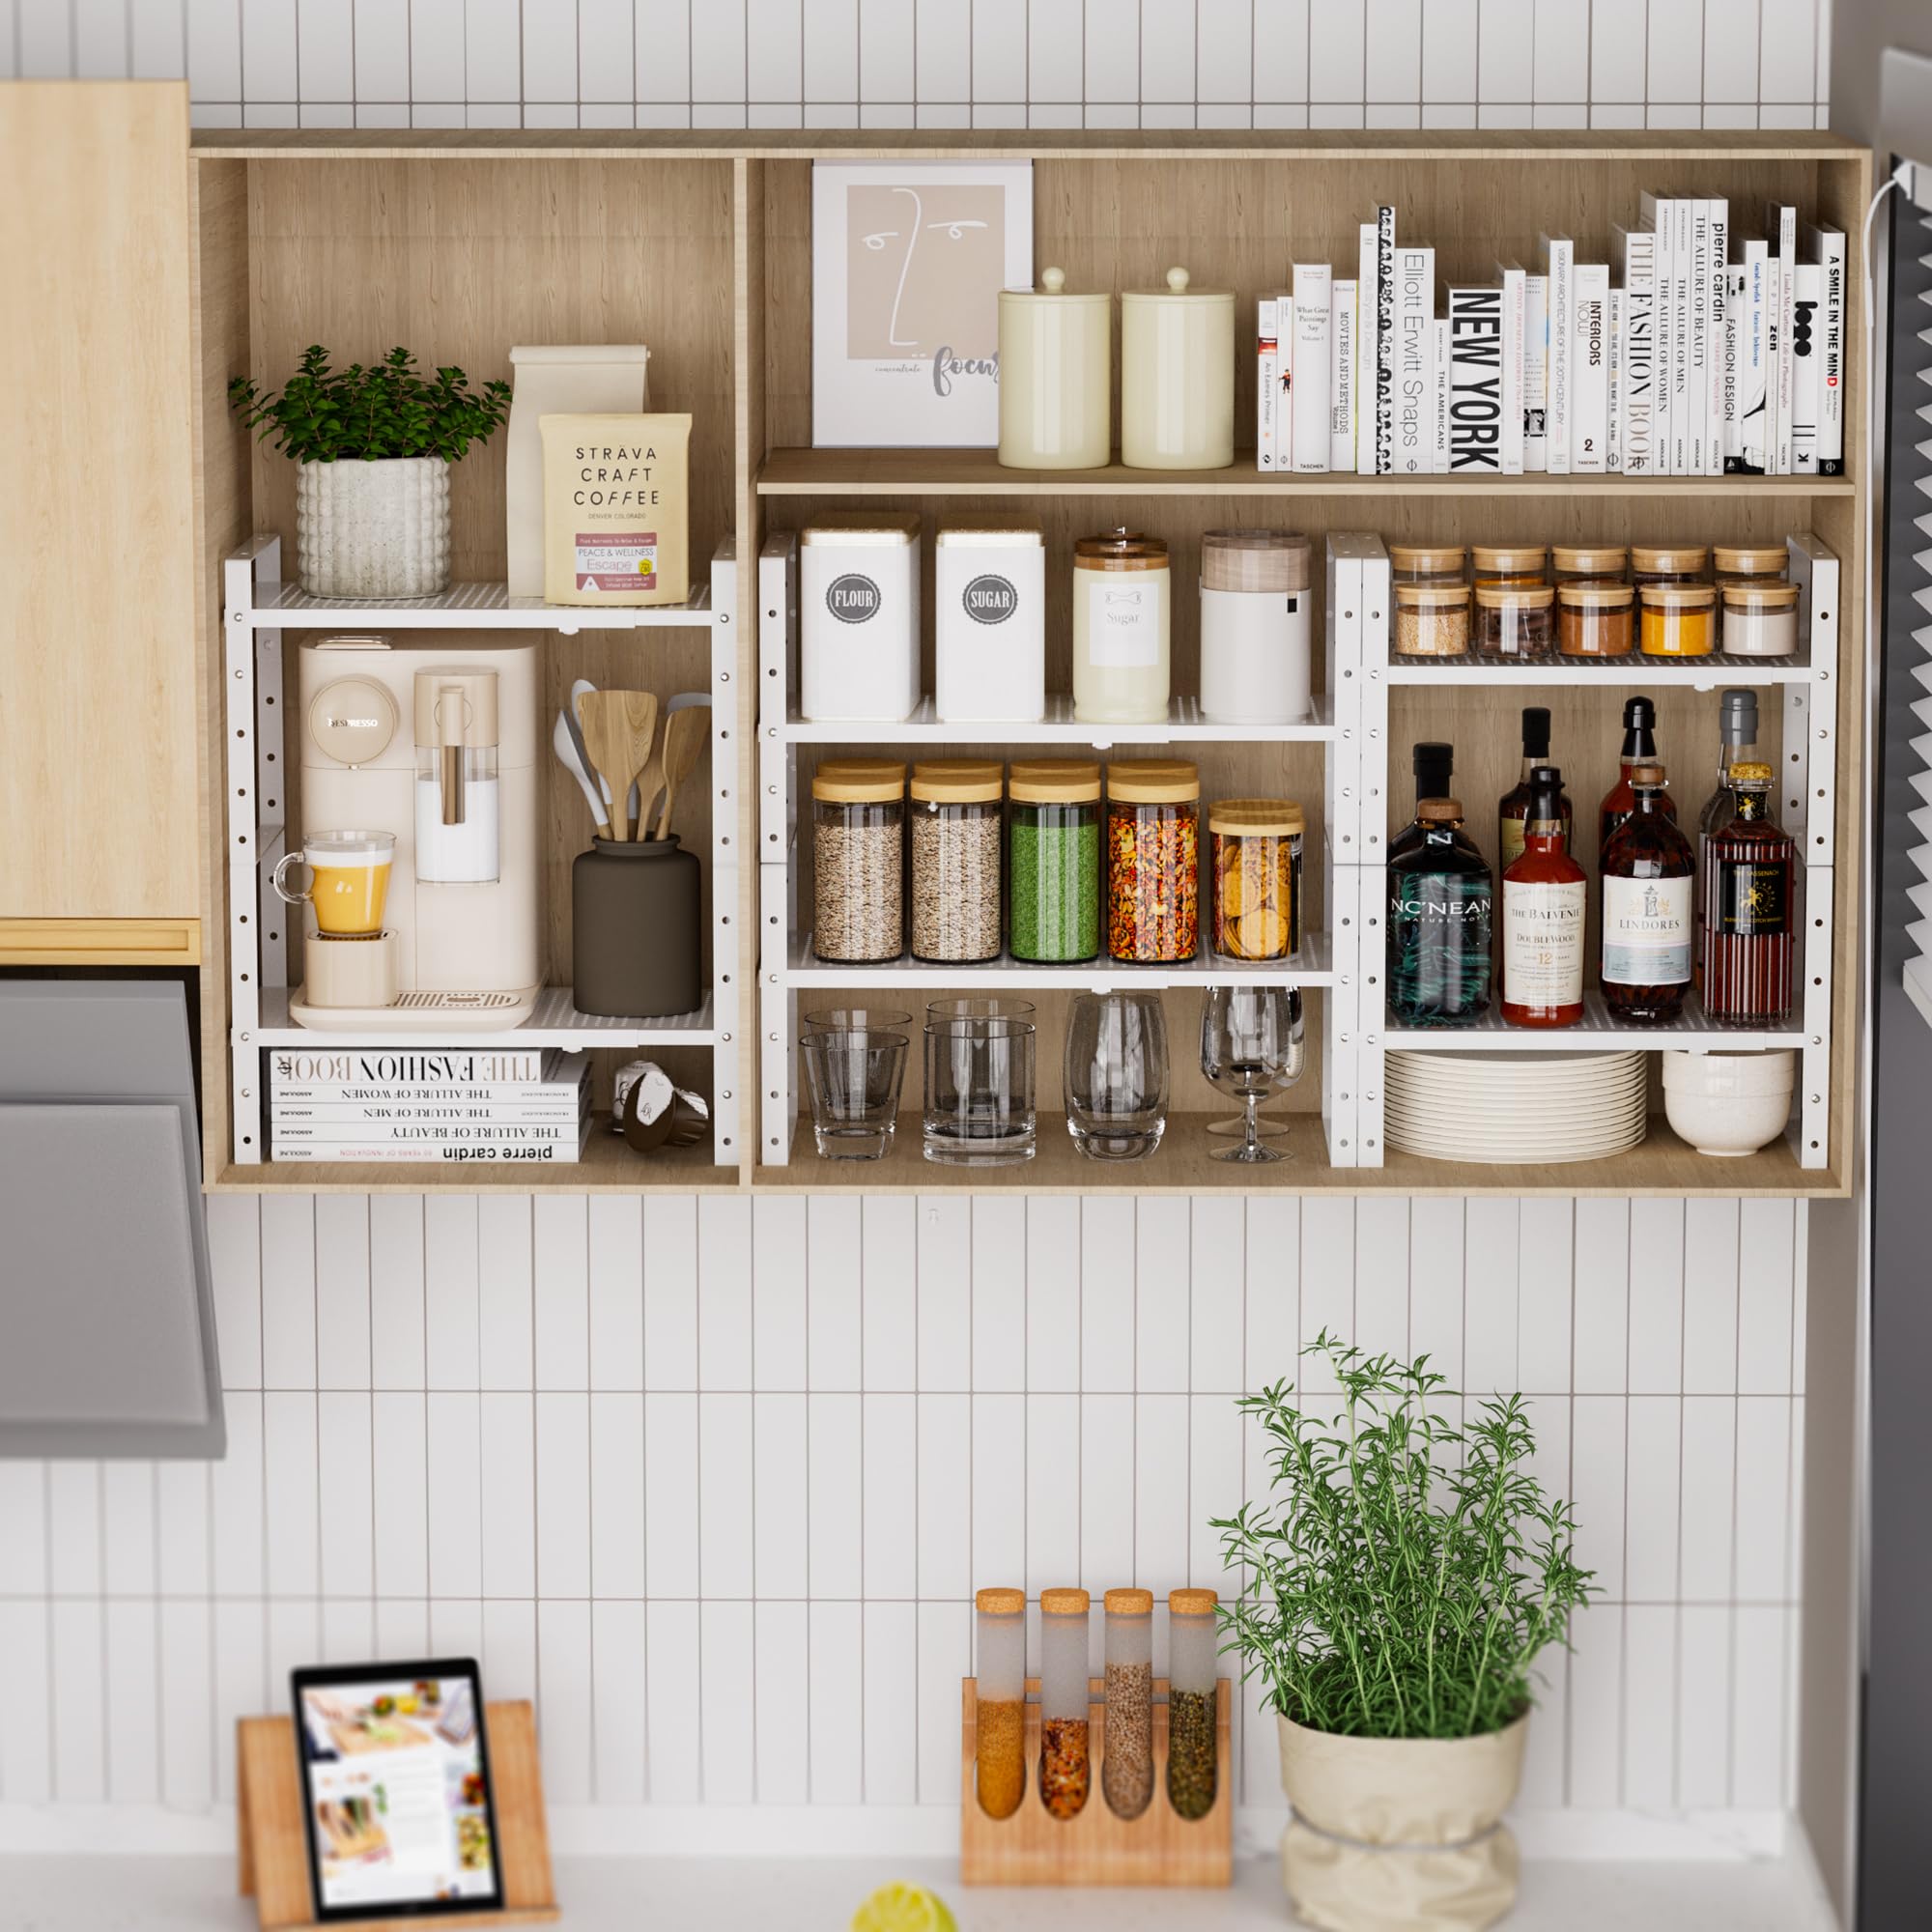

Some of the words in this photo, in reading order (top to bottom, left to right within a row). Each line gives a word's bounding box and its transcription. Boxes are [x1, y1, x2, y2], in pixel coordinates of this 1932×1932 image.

[1695, 215, 1706, 242] THE
[1712, 223, 1727, 269] pierre
[1630, 236, 1654, 287] THE
[1694, 244, 1705, 295] ALLURE
[1829, 255, 1840, 265] A
[1404, 254, 1424, 308] Elliott
[1660, 277, 1669, 301] THE
[1677, 277, 1686, 301] THE
[1828, 268, 1840, 306] SMILE
[1694, 298, 1705, 314] OF
[1713, 273, 1725, 323] cardin
[1660, 303, 1668, 348] ALLURE
[1677, 303, 1686, 348] ALLURE
[1828, 309, 1838, 323] IN
[1339, 312, 1349, 356] MOVIES
[1452, 293, 1500, 367] NEW
[1589, 300, 1602, 366] INTERIORS
[1828, 327, 1838, 349] THE
[1404, 317, 1424, 372] Erwitt
[1628, 294, 1653, 396] FASHION
[1693, 318, 1704, 368] BEAUTY
[1725, 319, 1736, 372] FASHION
[1264, 362, 1271, 372] An
[1660, 350, 1668, 366] OF
[1676, 350, 1685, 366] OF
[1339, 357, 1349, 381] AND
[1827, 353, 1838, 387] MIND
[1659, 368, 1667, 412] WOMEN
[1676, 368, 1685, 393] MEN
[1724, 376, 1735, 421] DESIGN
[1339, 383, 1349, 434] METHODS
[1399, 380, 1424, 447] Snaps
[1450, 378, 1500, 469] YORK
[1583, 439, 1593, 452] 2
[581, 468, 652, 482] CRAFT
[574, 491, 659, 505] COFFEE
[579, 548, 606, 557] PEACE
[607, 549, 613, 557] &
[614, 548, 654, 557] WELLNESS
[586, 558, 633, 572] Escape
[835, 589, 873, 608] FLOUR
[971, 590, 1010, 609] SUGAR
[1106, 611, 1140, 627] Sugar
[1390, 896, 1492, 916] NC'NEAN
[1512, 908, 1526, 919] THE
[1619, 919, 1681, 929] LINDORES
[1538, 952, 1553, 965] 12
[360, 1056, 473, 1081] FASHION
[481, 1057, 537, 1081] THE
[342, 1089, 391, 1098] WOMEN
[394, 1089, 411, 1098] OF
[413, 1089, 463, 1098] ALLURE
[466, 1089, 493, 1098] THE
[363, 1108, 391, 1118] MEN
[394, 1108, 411, 1118] OF
[413, 1108, 463, 1118] ALLURE
[466, 1108, 493, 1118] THE
[390, 1127, 448, 1138] BEAUTY
[451, 1127, 470, 1138] OF
[473, 1127, 528, 1138] ALLURE
[532, 1127, 561, 1138] THE
[442, 1147, 497, 1161] cardin
[502, 1145, 553, 1161] pierre
